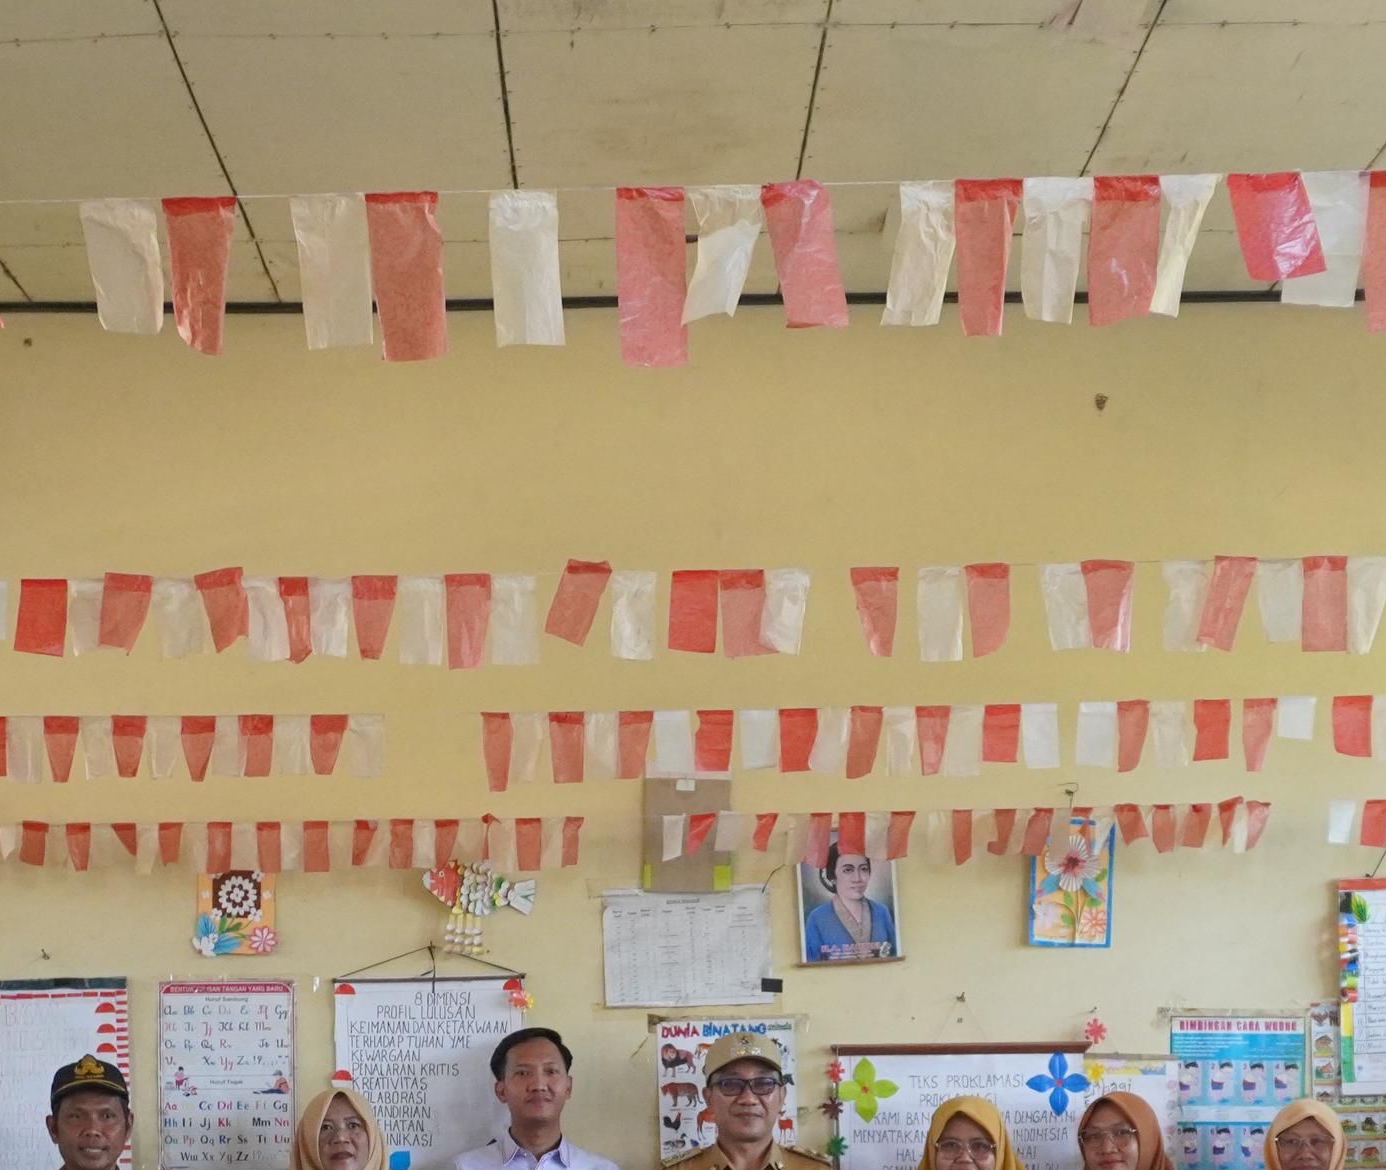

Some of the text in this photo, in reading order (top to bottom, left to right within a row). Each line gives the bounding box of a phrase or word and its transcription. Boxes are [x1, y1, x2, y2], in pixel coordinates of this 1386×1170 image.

[415, 991, 471, 1006] 8 DIMENSI
[377, 1005, 476, 1020] PROFIL LULUSAN
[350, 1020, 411, 1035] KEIMANAN
[437, 1020, 508, 1034] KETAKWAAN
[1237, 1021, 1261, 1031] CARA
[349, 1034, 471, 1050] TERHADAP TUHAN YME
[351, 1050, 421, 1062] KEWARGAAN
[352, 1063, 460, 1076] PENALARAN KRITIS
[353, 1077, 428, 1091] KREATIVITAS
[909, 1074, 1024, 1089] TEKS PROKLAMASI
[361, 1090, 427, 1105] OLABORASI
[875, 1112, 901, 1126] KAMI
